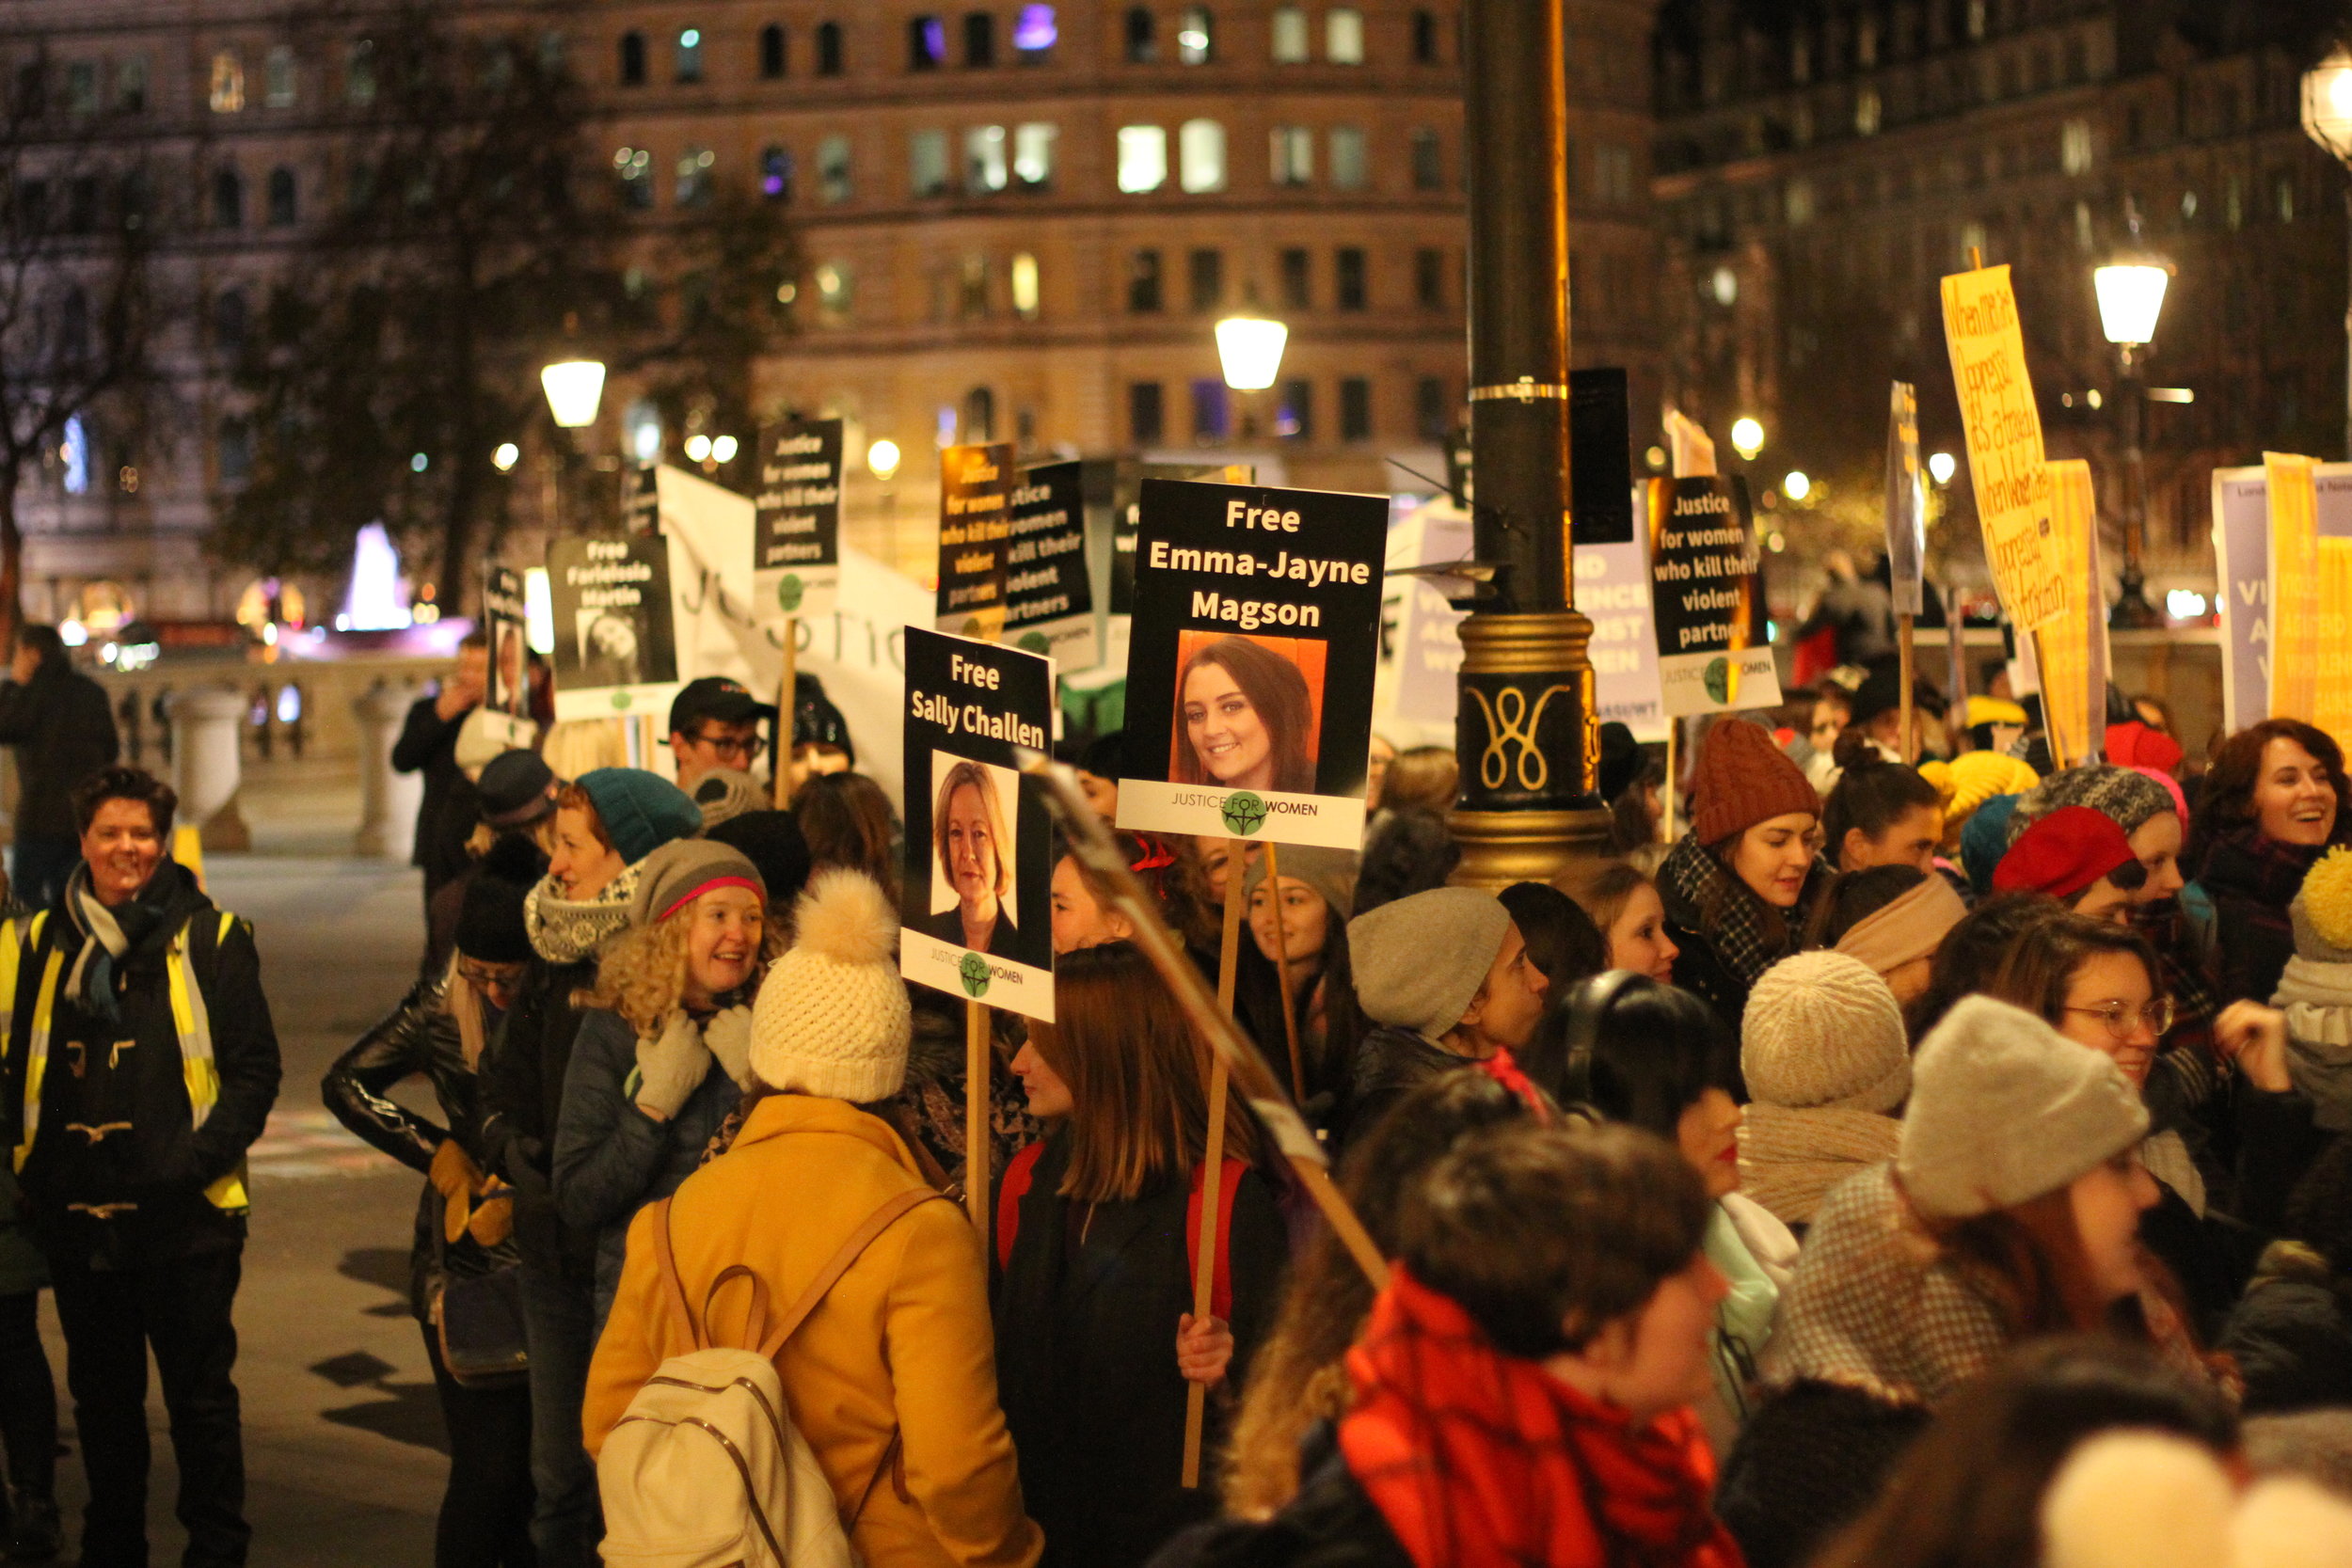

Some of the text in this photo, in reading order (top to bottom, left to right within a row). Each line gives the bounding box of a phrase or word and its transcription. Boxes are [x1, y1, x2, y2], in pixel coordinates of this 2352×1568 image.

[1226, 499, 1301, 533] Free
[1674, 492, 1730, 517] Justice
[586, 540, 628, 561] Free
[1660, 527, 1744, 549] for women
[1150, 540, 1371, 588] Emma-Jayne
[1654, 553, 1758, 582] who kill their
[1191, 590, 1321, 631] Magson
[1681, 586, 1740, 611] violent
[951, 654, 1001, 690] Free
[911, 689, 1044, 750] Sally Challen
[1171, 793, 1318, 816] JUSTICE FOR WOMEN
[930, 947, 1024, 986] JUSTICE FOR WOMEN
